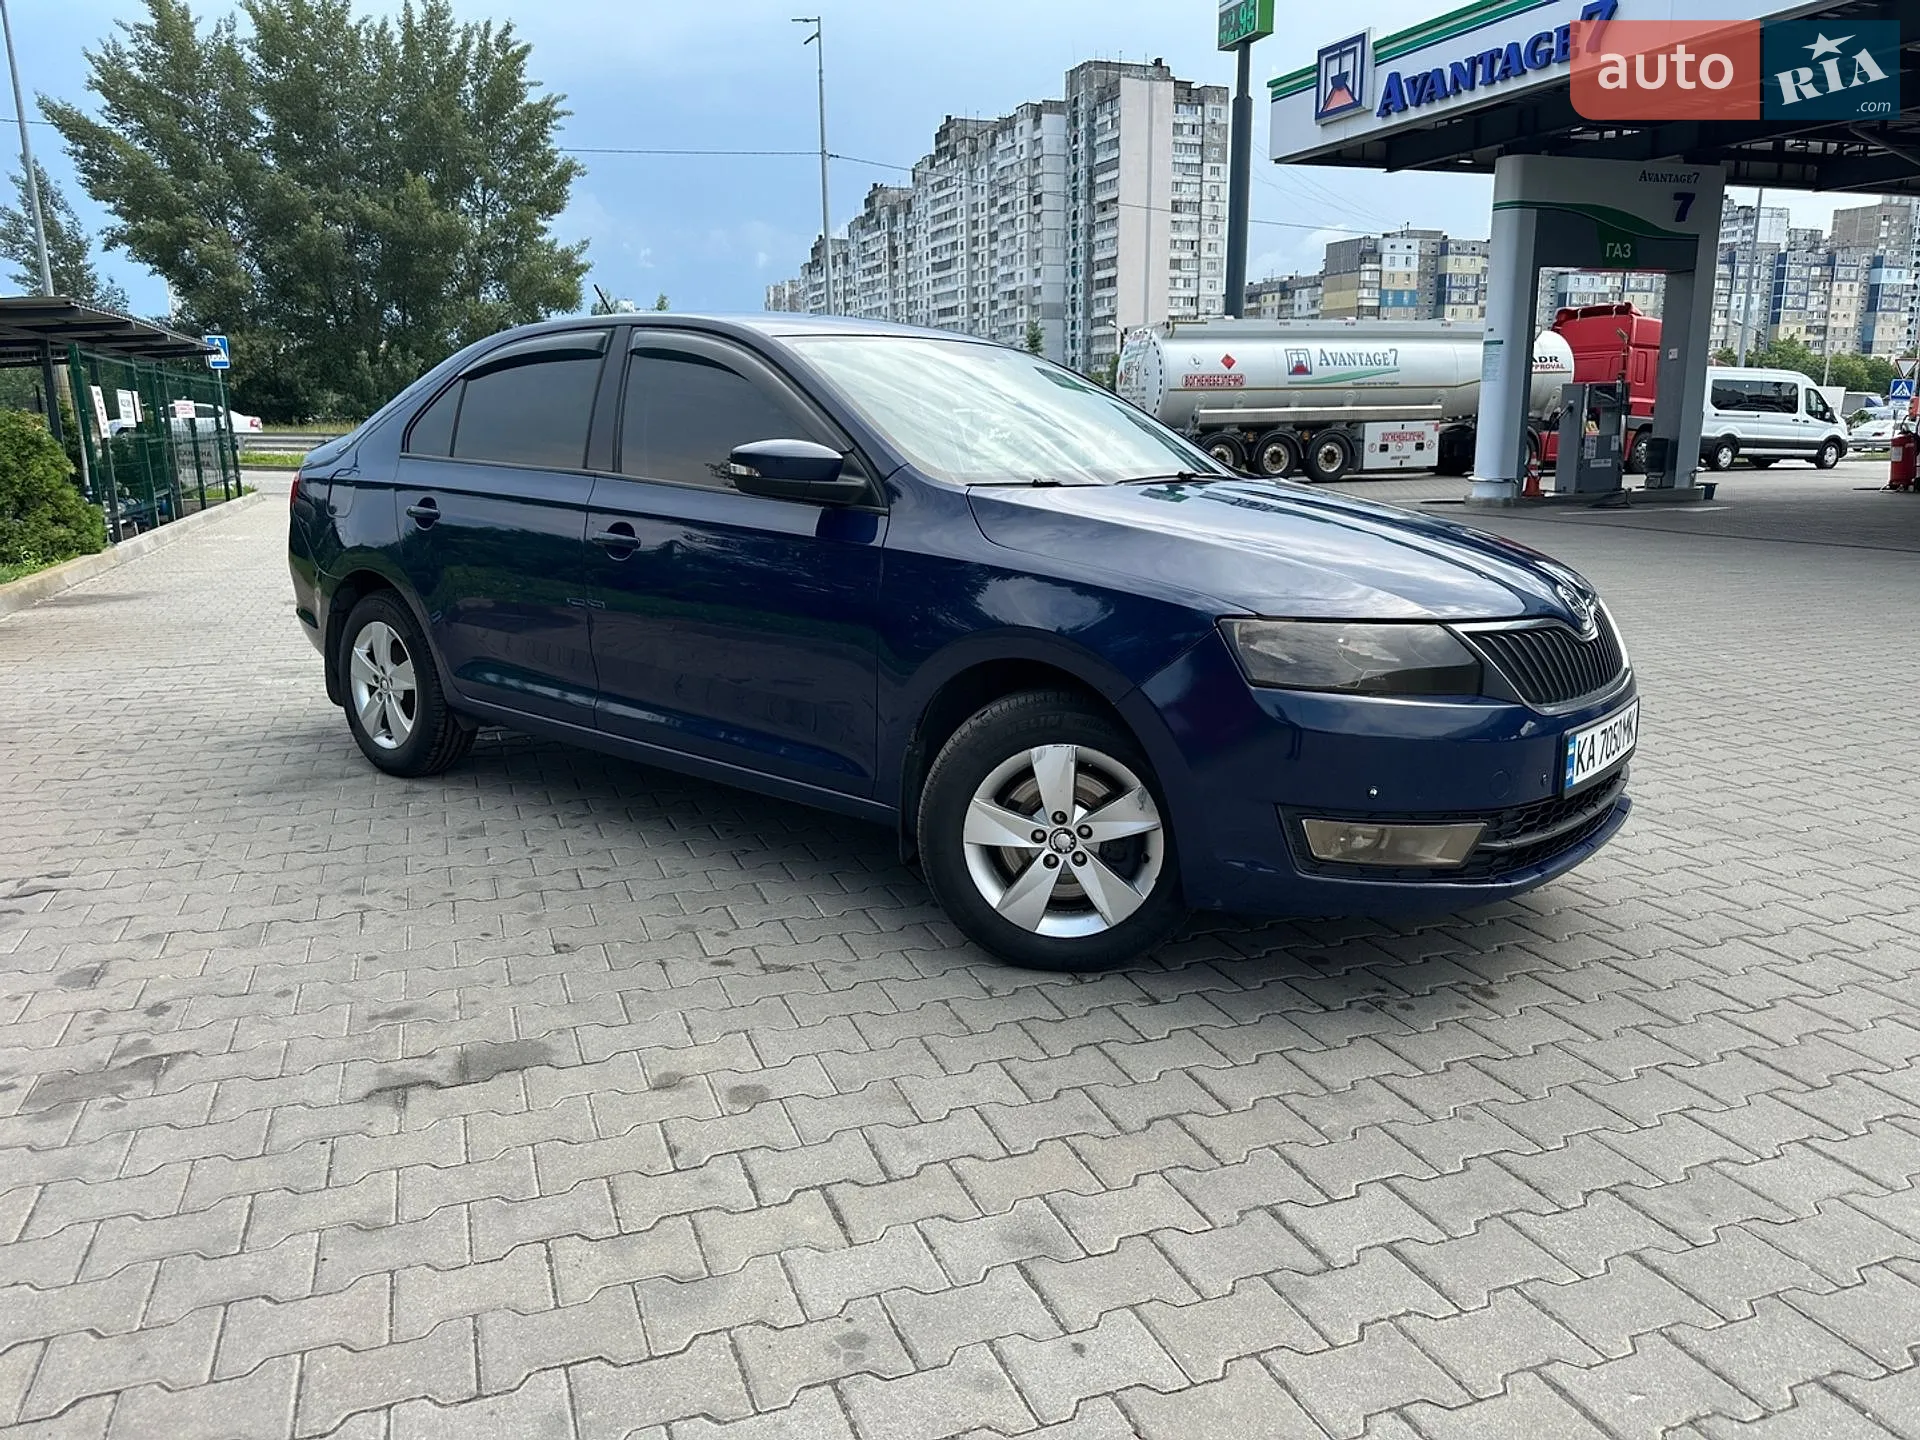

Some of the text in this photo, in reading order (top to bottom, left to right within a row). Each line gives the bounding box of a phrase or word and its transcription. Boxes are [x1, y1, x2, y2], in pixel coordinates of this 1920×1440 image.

[1673, 192, 1696, 222] 7
[1606, 242, 1632, 258] ГАЗ
[1576, 734, 1596, 776] KA
